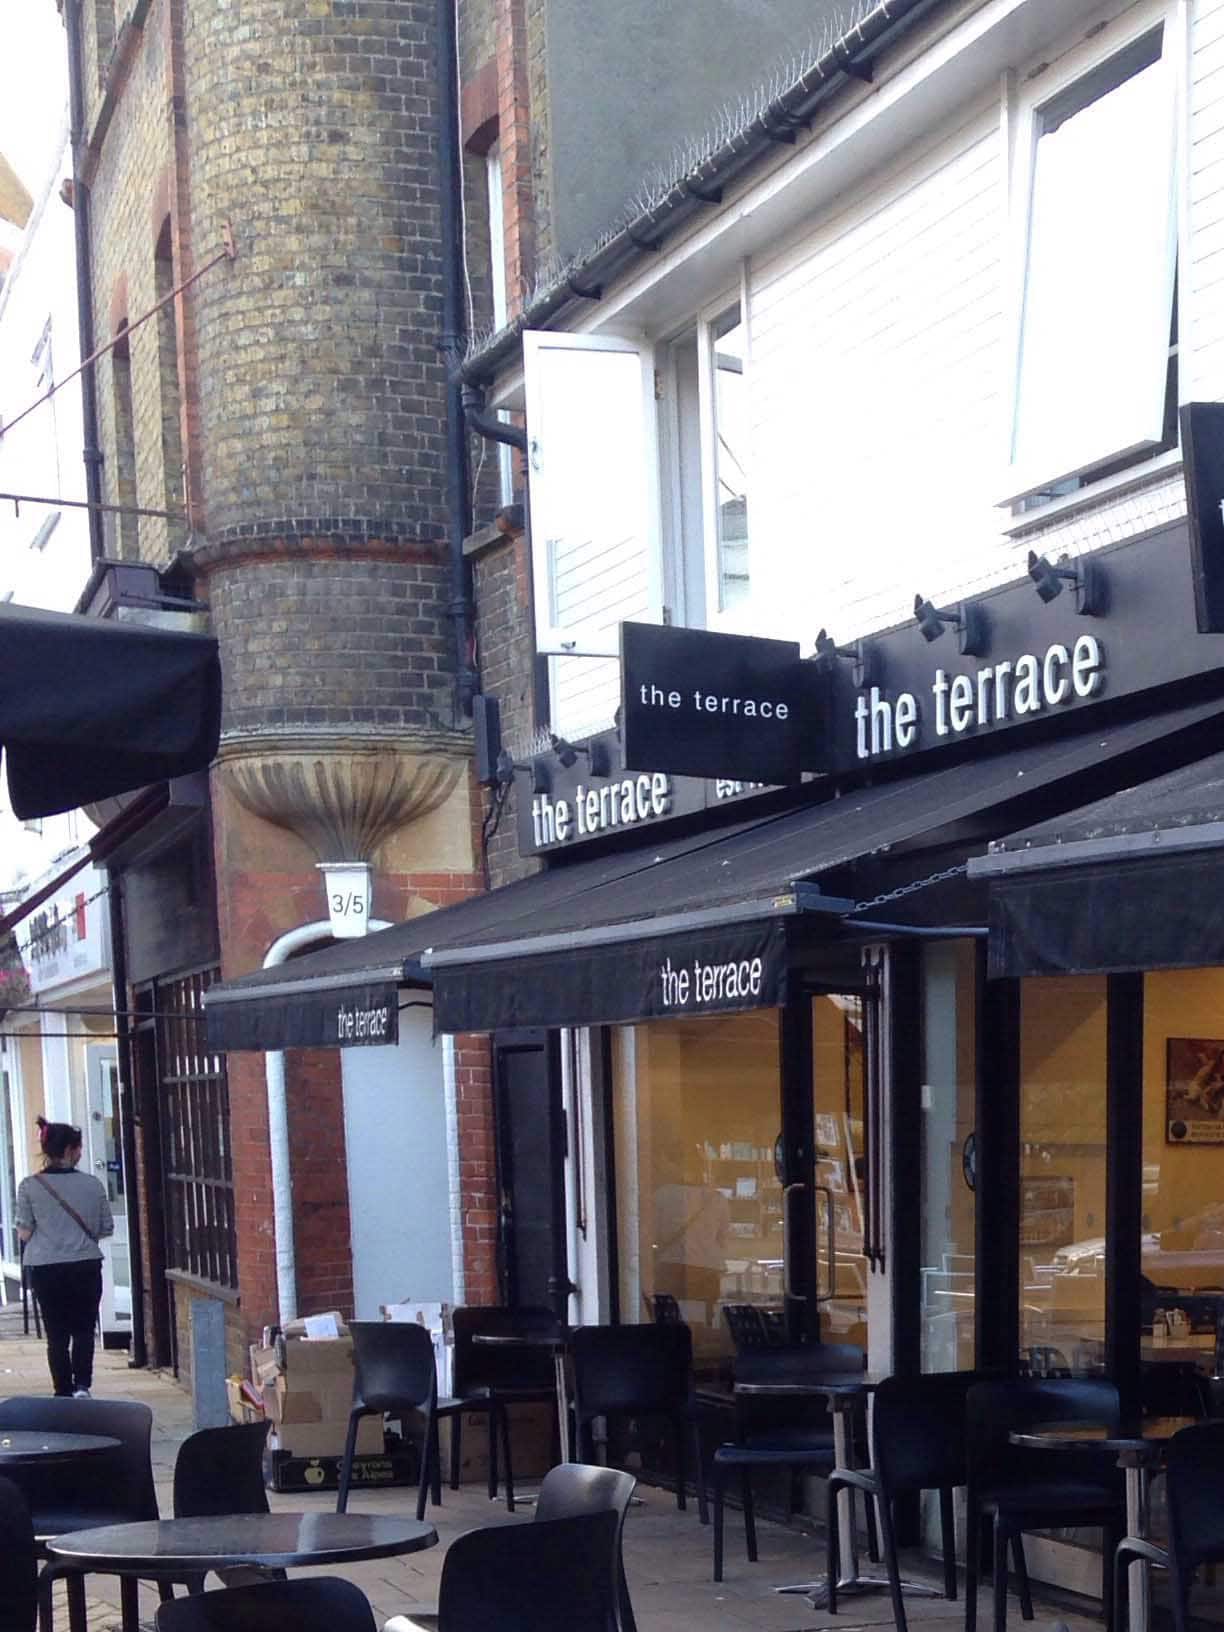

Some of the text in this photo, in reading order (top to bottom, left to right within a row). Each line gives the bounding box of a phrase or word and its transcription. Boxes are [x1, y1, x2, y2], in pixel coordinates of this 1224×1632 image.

[639, 684, 790, 720] the terrace
[854, 635, 1100, 759] the terrace
[531, 772, 669, 848] the terrace
[332, 891, 364, 916] 3/5
[660, 956, 763, 1006] the terrace
[338, 1004, 388, 1039] the terrace
